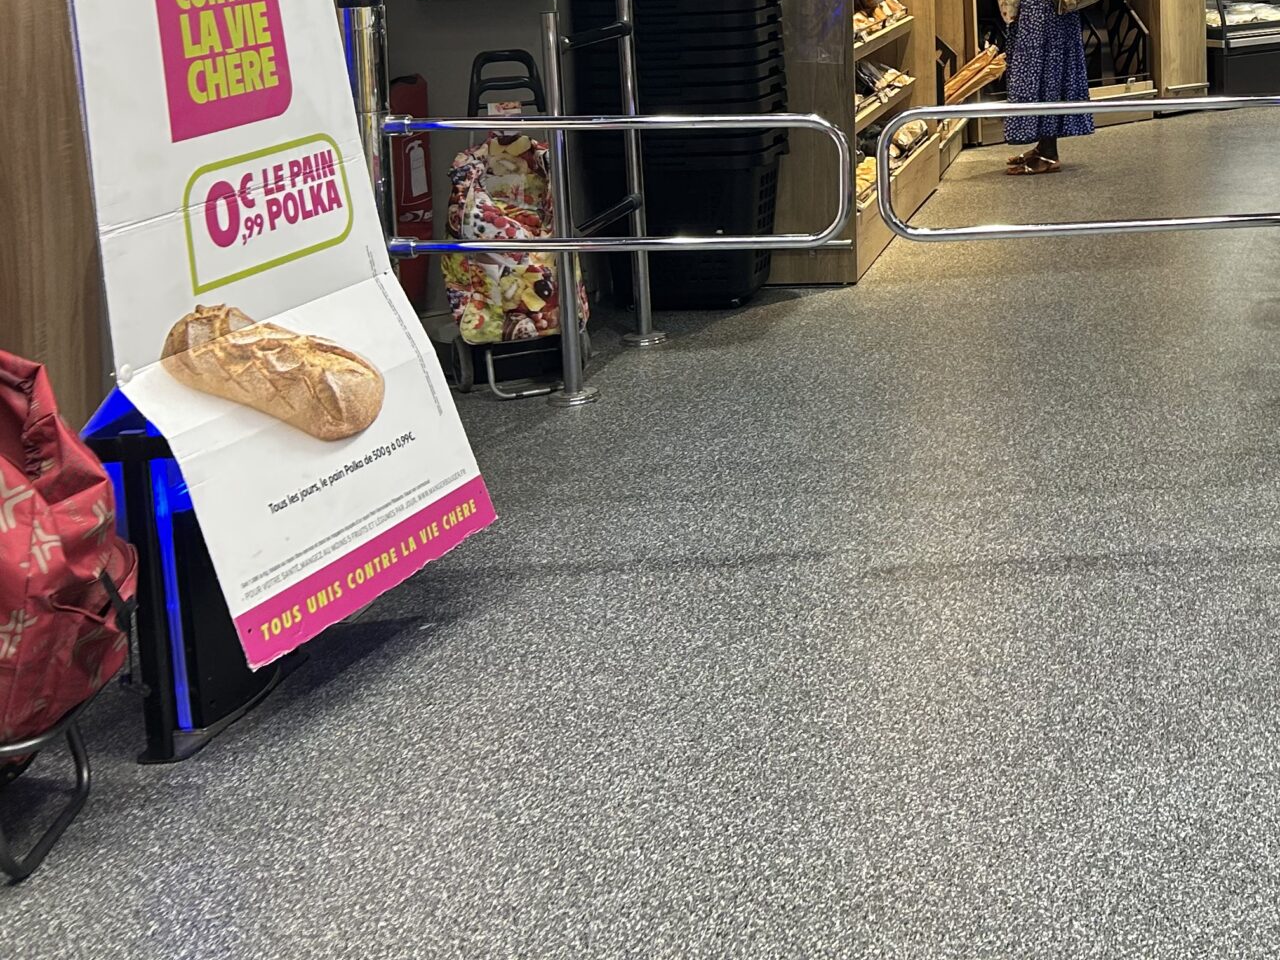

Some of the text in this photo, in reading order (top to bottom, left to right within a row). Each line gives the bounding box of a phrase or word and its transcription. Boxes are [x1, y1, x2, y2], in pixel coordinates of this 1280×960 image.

[179, 1, 272, 59] LA VIE
[187, 45, 279, 105] CHÈRE
[262, 164, 286, 197] LE
[288, 149, 336, 189] PAIN
[266, 179, 343, 231] POLKA
[267, 496, 288, 515] Tous
[286, 490, 299, 505] les
[296, 479, 321, 501] jours,
[318, 475, 328, 488] le
[326, 467, 345, 486] pain
[343, 457, 364, 475] Polka
[362, 452, 373, 464] de
[260, 605, 302, 641] TOUS
[306, 581, 342, 614] UNIS
[347, 547, 398, 589] CONTRE
[401, 538, 417, 557] LA
[419, 522, 439, 544] VIE
[442, 498, 477, 530] CHÈRE
